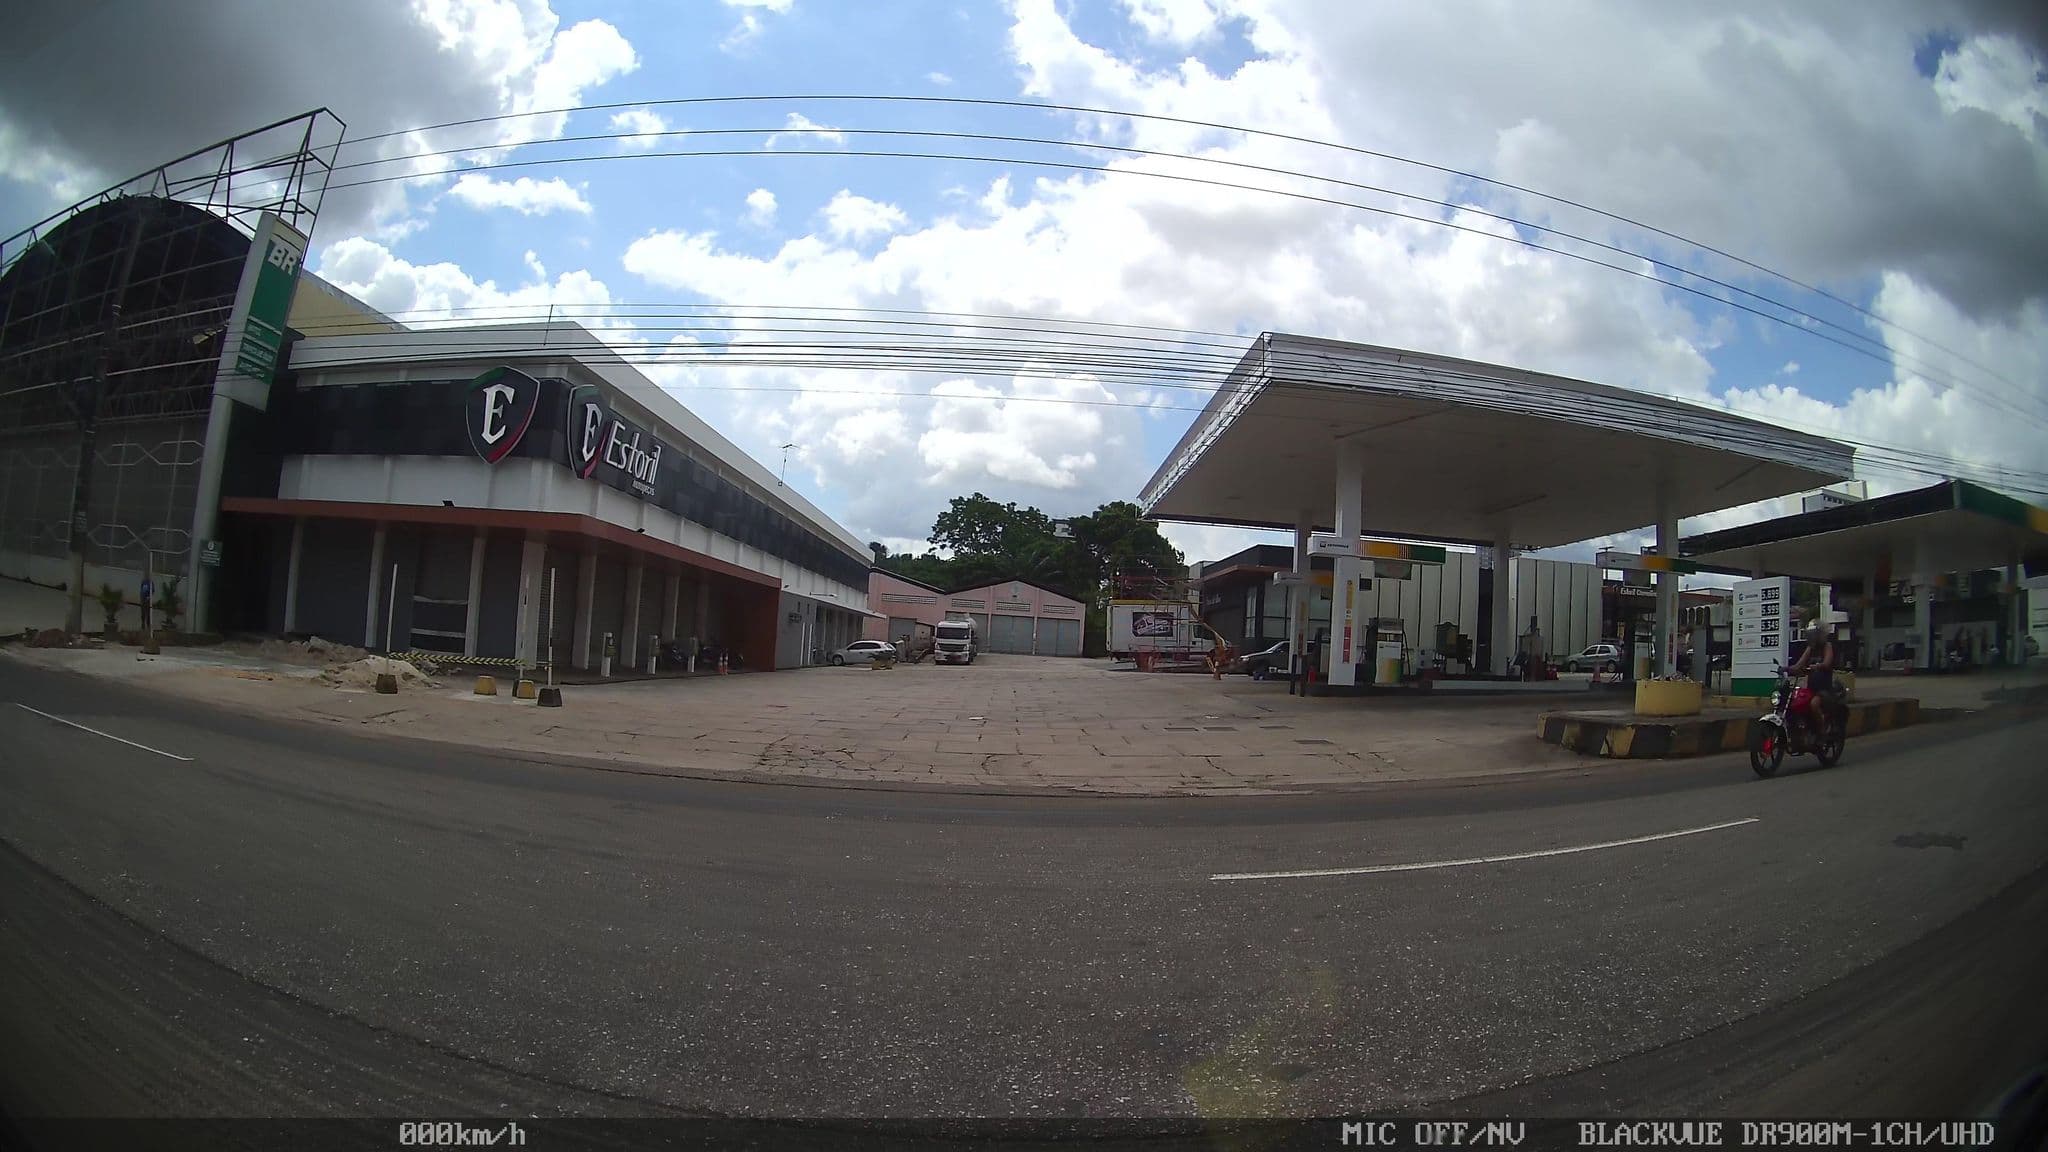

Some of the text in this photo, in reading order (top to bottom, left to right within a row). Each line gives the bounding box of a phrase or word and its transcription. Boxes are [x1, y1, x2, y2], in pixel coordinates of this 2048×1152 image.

[268, 245, 298, 276] BR
[481, 383, 515, 446] E
[604, 420, 661, 485] Estoril
